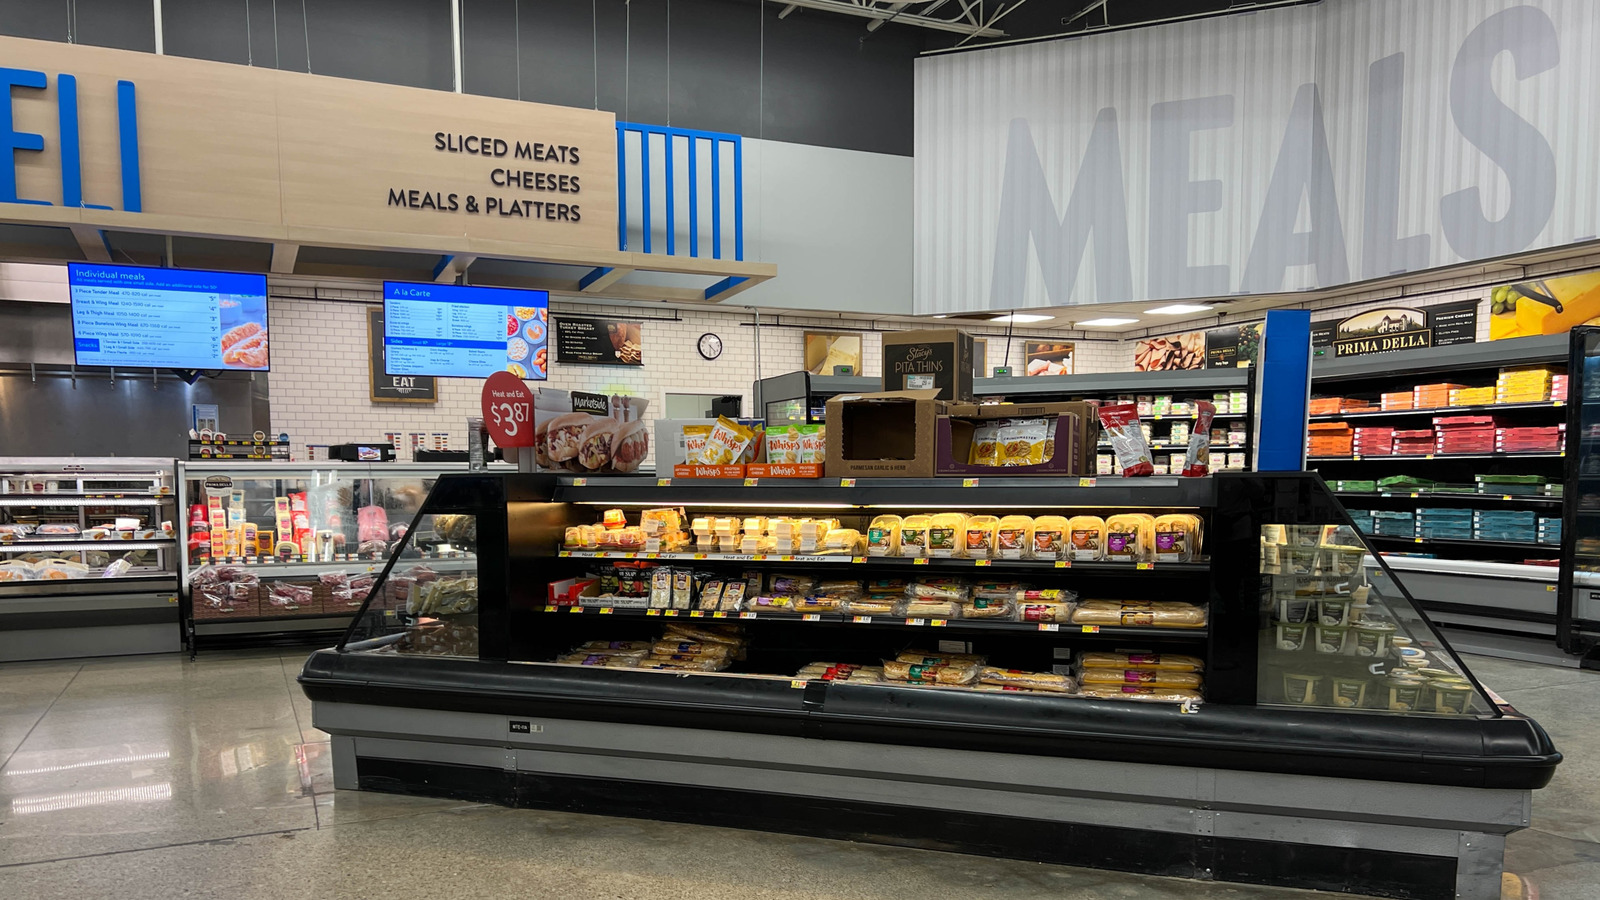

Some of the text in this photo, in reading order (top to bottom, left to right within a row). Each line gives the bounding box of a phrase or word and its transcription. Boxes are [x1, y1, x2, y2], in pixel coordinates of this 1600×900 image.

[434, 132, 580, 164] SLICED MEATS
[988, 4, 1561, 308] MEALS
[490, 168, 581, 193] CHEESES
[387, 188, 581, 222] MEALS & PLATTERS
[75, 269, 146, 281] Individual meals
[409, 289, 431, 297] Carte
[1337, 341, 1379, 356] PRIMA
[1382, 335, 1424, 350] DELLA
[906, 347, 933, 361] Stacy's
[895, 360, 943, 373] PITA THINS
[392, 376, 416, 387] EAT
[491, 389, 525, 398] Heat and Eat
[712, 428, 742, 453] Whisps
[769, 439, 800, 451] Whisps
[695, 466, 721, 477] Whisps
[769, 465, 796, 476] Whisps
